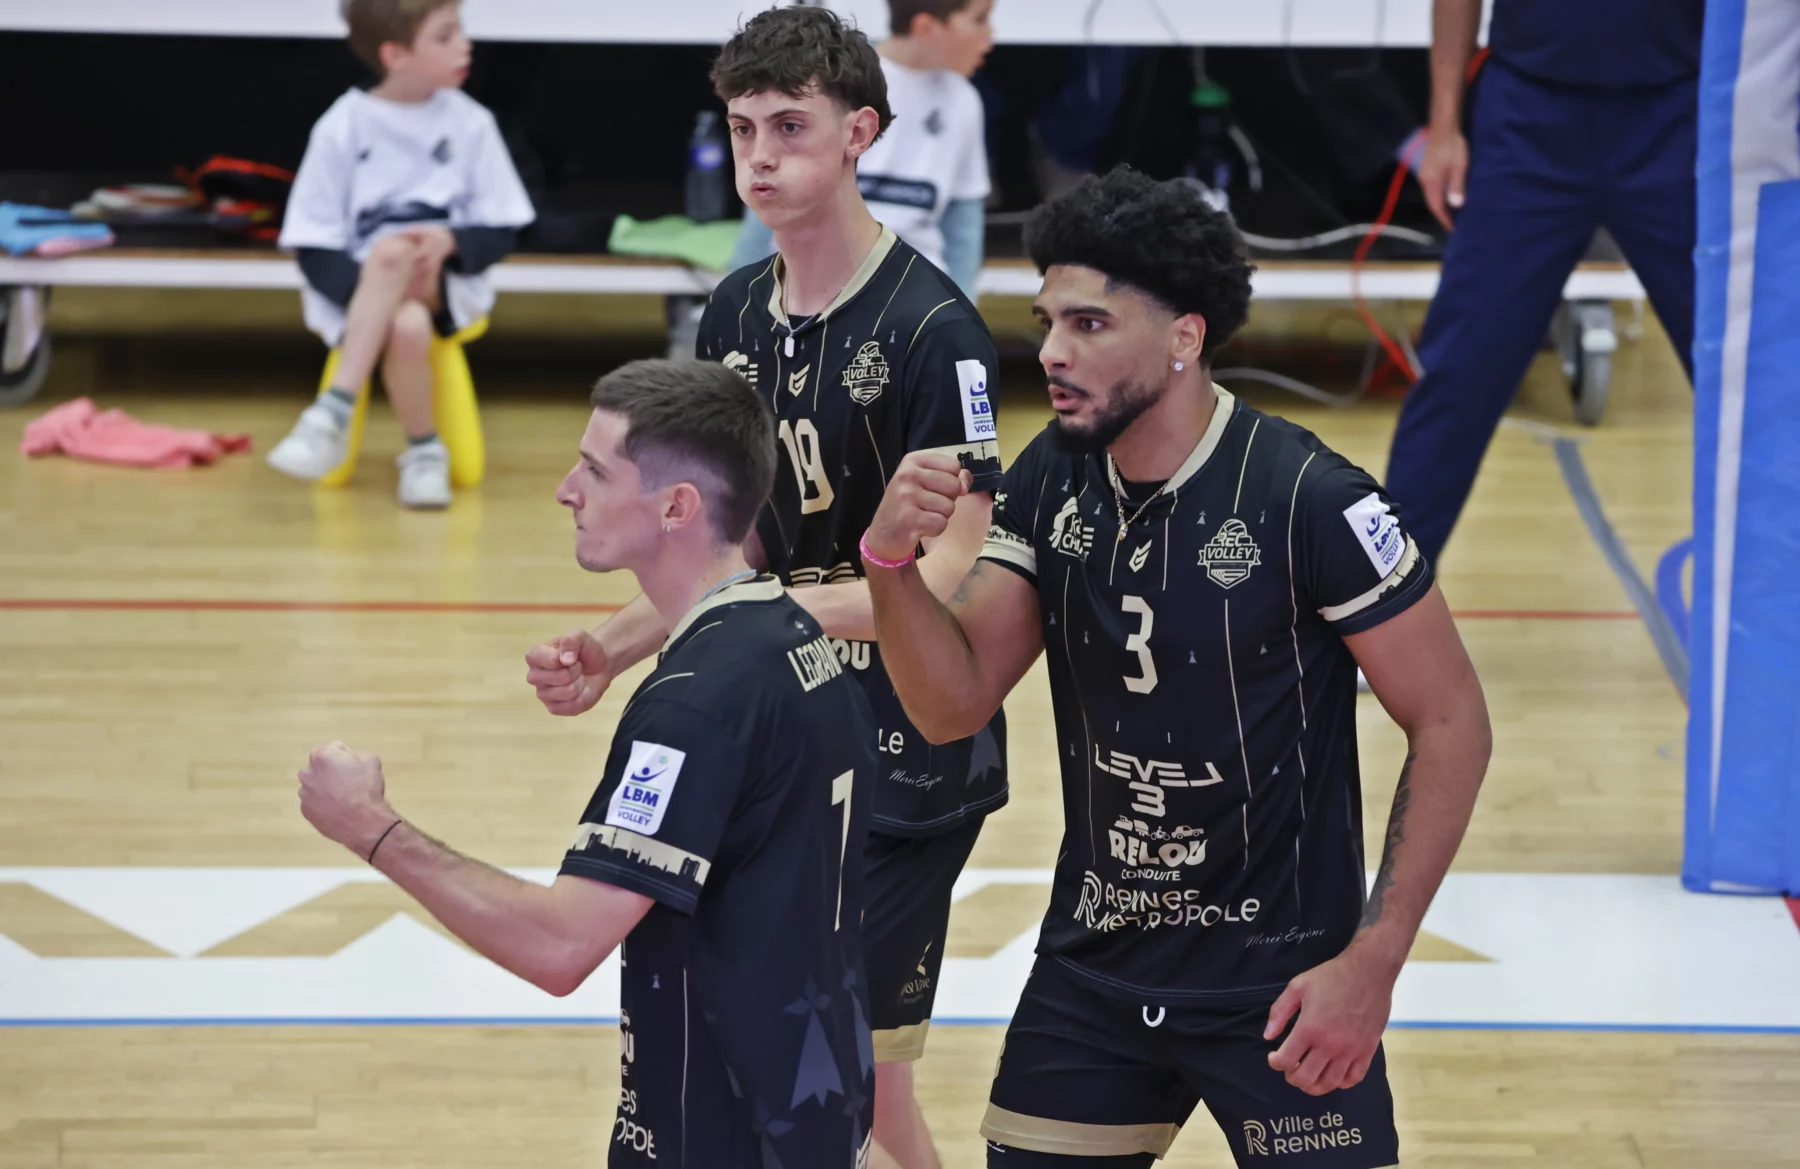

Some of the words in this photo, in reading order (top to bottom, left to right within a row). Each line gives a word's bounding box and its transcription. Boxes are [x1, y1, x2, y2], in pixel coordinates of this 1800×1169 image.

[1218, 531, 1245, 547] REC
[1207, 547, 1254, 560] VOLLEY
[1121, 594, 1159, 694] 3
[622, 785, 660, 808] LBM
[617, 810, 652, 826] VOLLEY
[831, 768, 854, 932] 1
[1108, 828, 1209, 868] RELOU
[1121, 868, 1181, 882] CONDUITE
[1269, 1115, 1314, 1135] Ville
[1319, 1111, 1344, 1129] de
